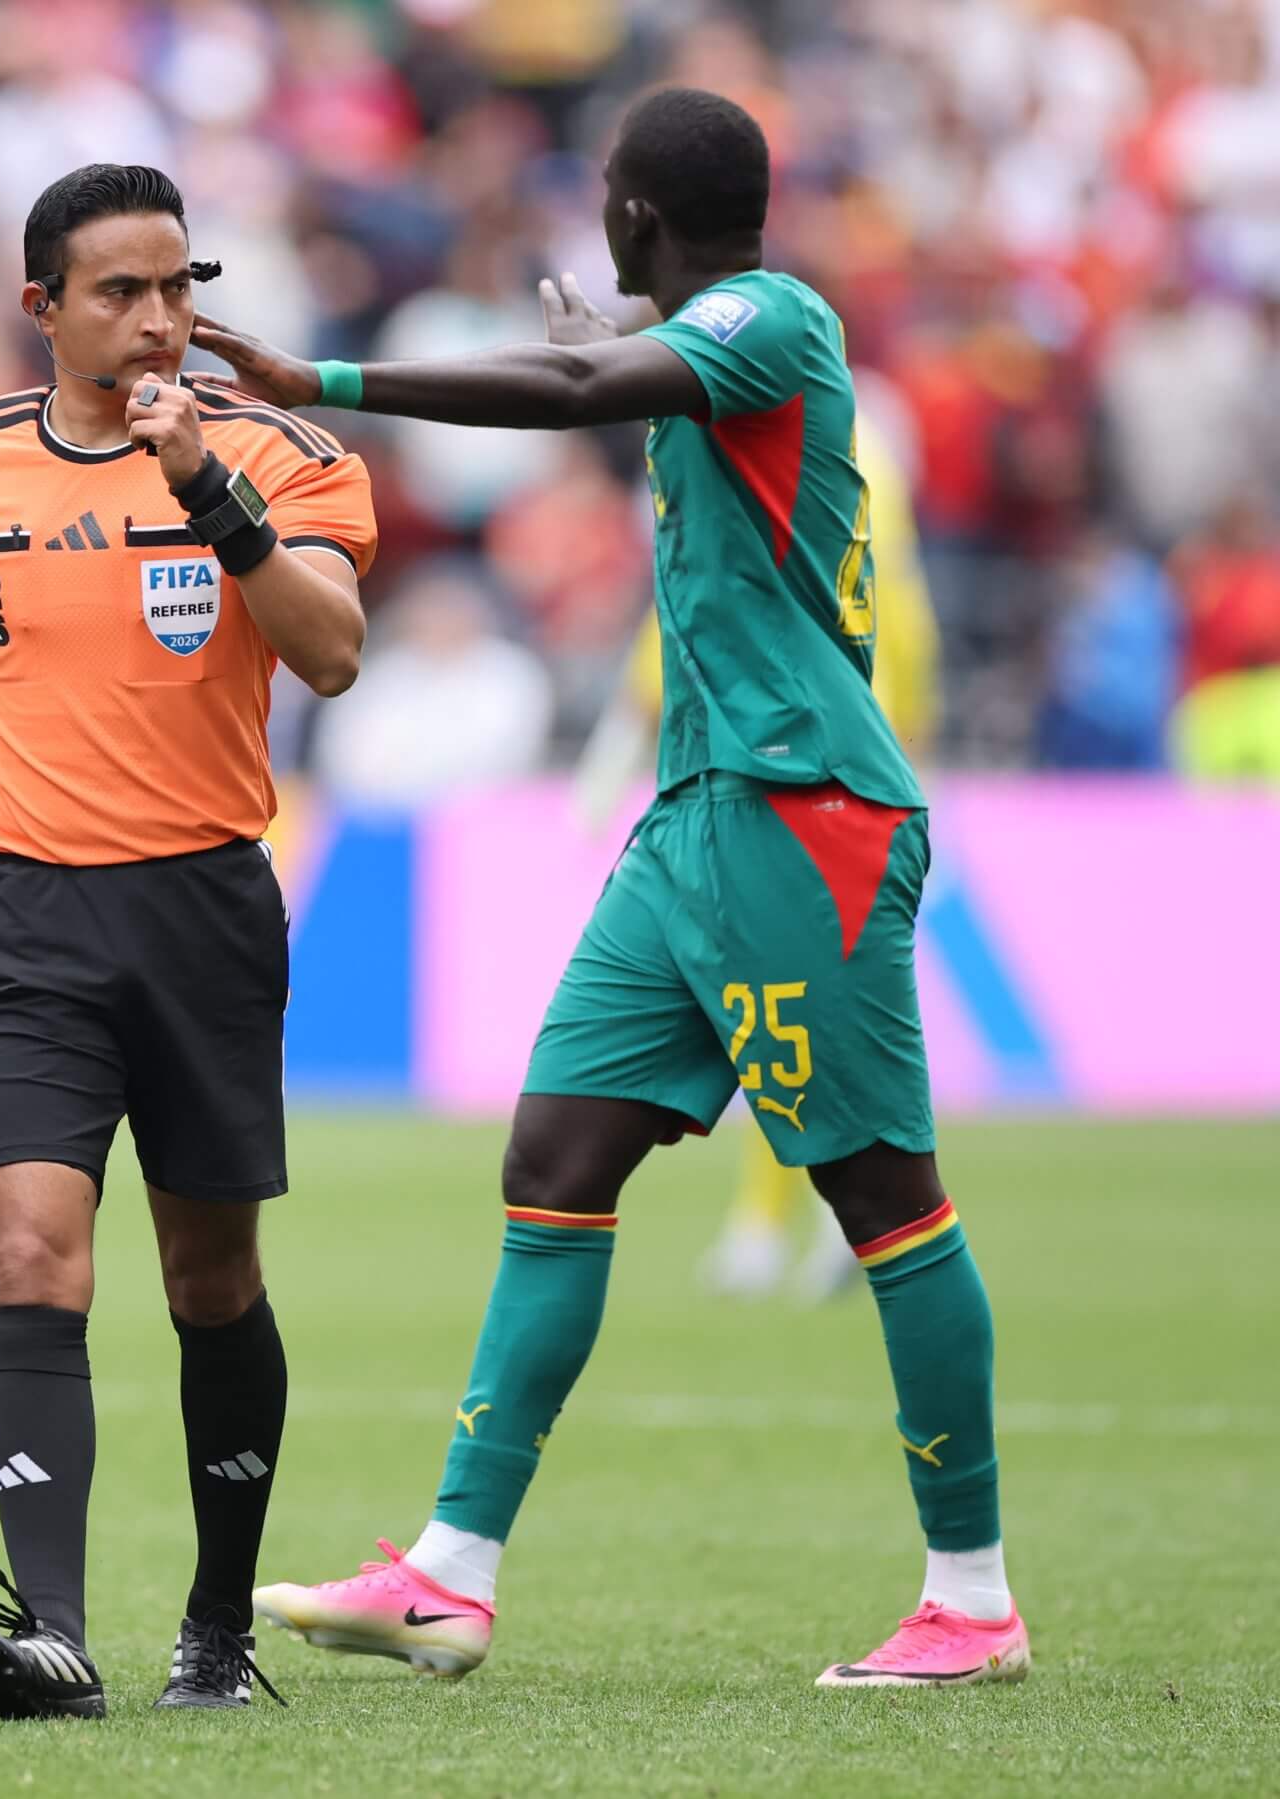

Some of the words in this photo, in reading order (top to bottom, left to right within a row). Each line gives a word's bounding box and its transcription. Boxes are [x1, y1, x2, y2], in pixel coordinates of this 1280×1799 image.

[149, 564, 215, 590] FIFA
[151, 601, 214, 618] REFEREE
[170, 635, 200, 648] 2026
[722, 981, 812, 1089] 25
